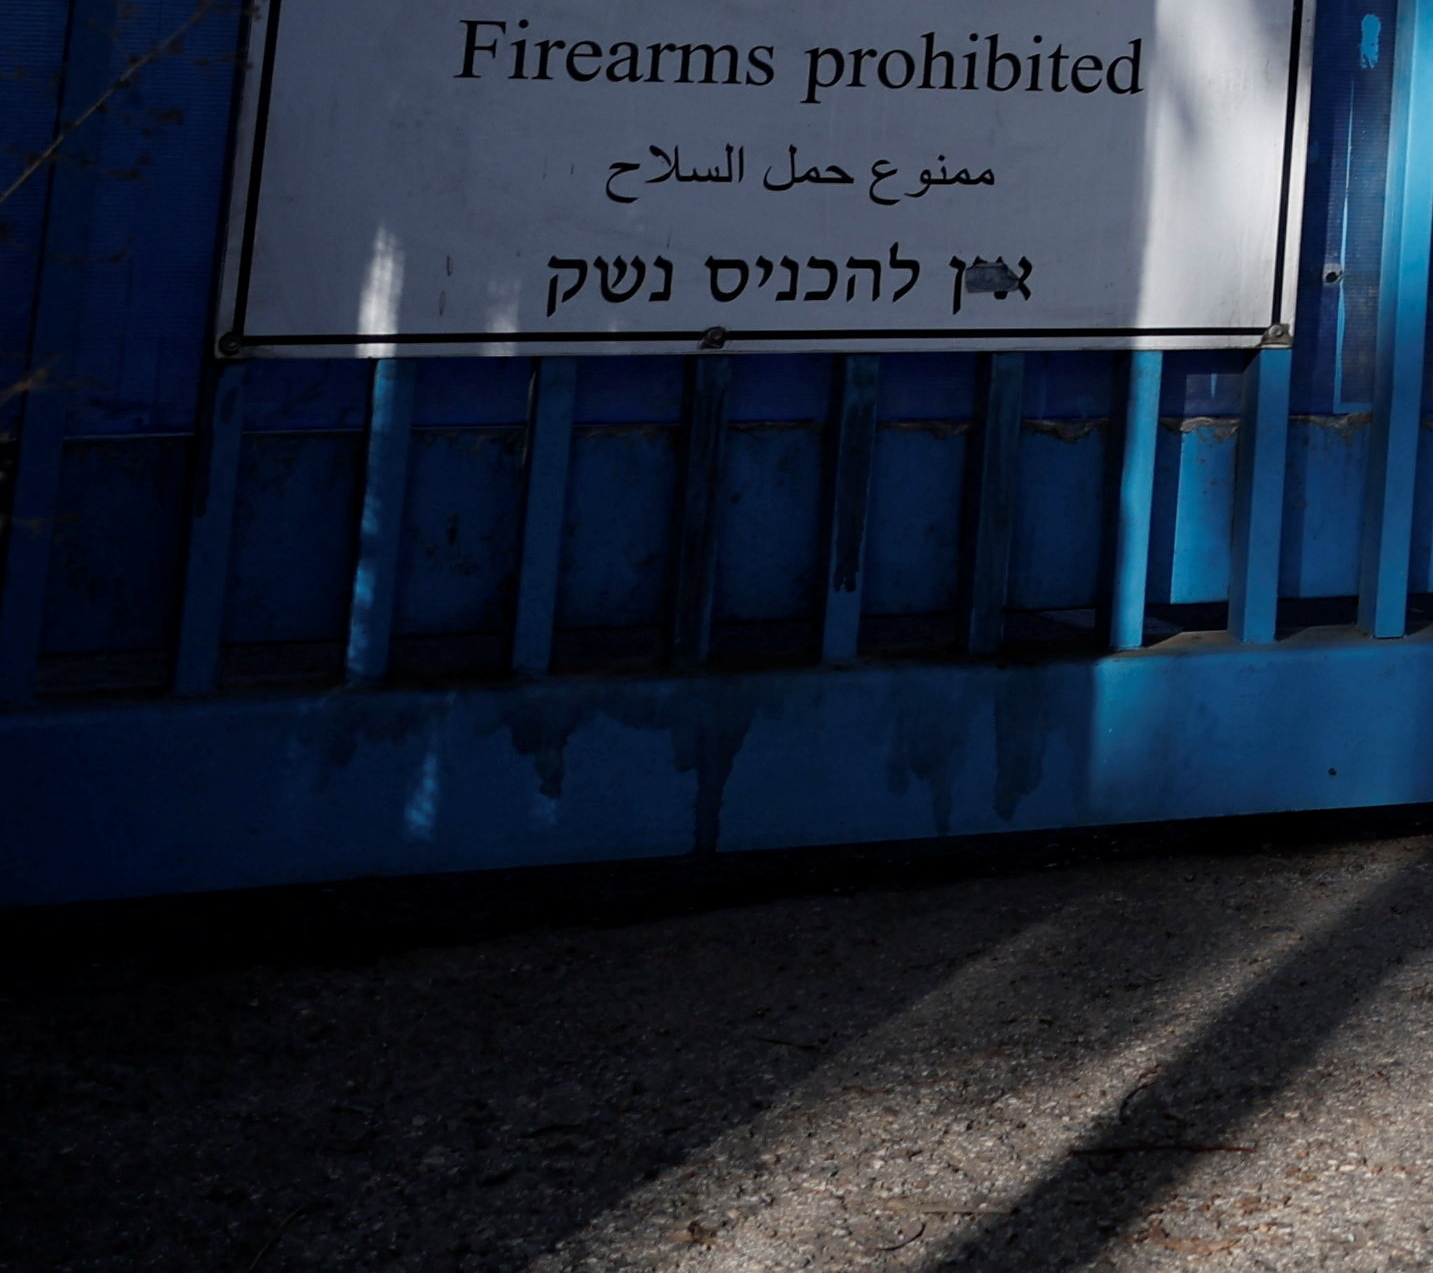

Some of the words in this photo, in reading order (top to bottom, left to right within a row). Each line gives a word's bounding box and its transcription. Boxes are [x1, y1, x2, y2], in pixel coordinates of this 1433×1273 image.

[453, 18, 775, 87] Firearms
[800, 31, 1144, 104] prohibited
[605, 142, 745, 205] السلاح
[762, 144, 855, 192] حمل
[868, 159, 996, 206] ممنوع
[545, 254, 673, 318] נשק
[705, 241, 921, 304] להכניס
[949, 255, 1033, 316] אן
